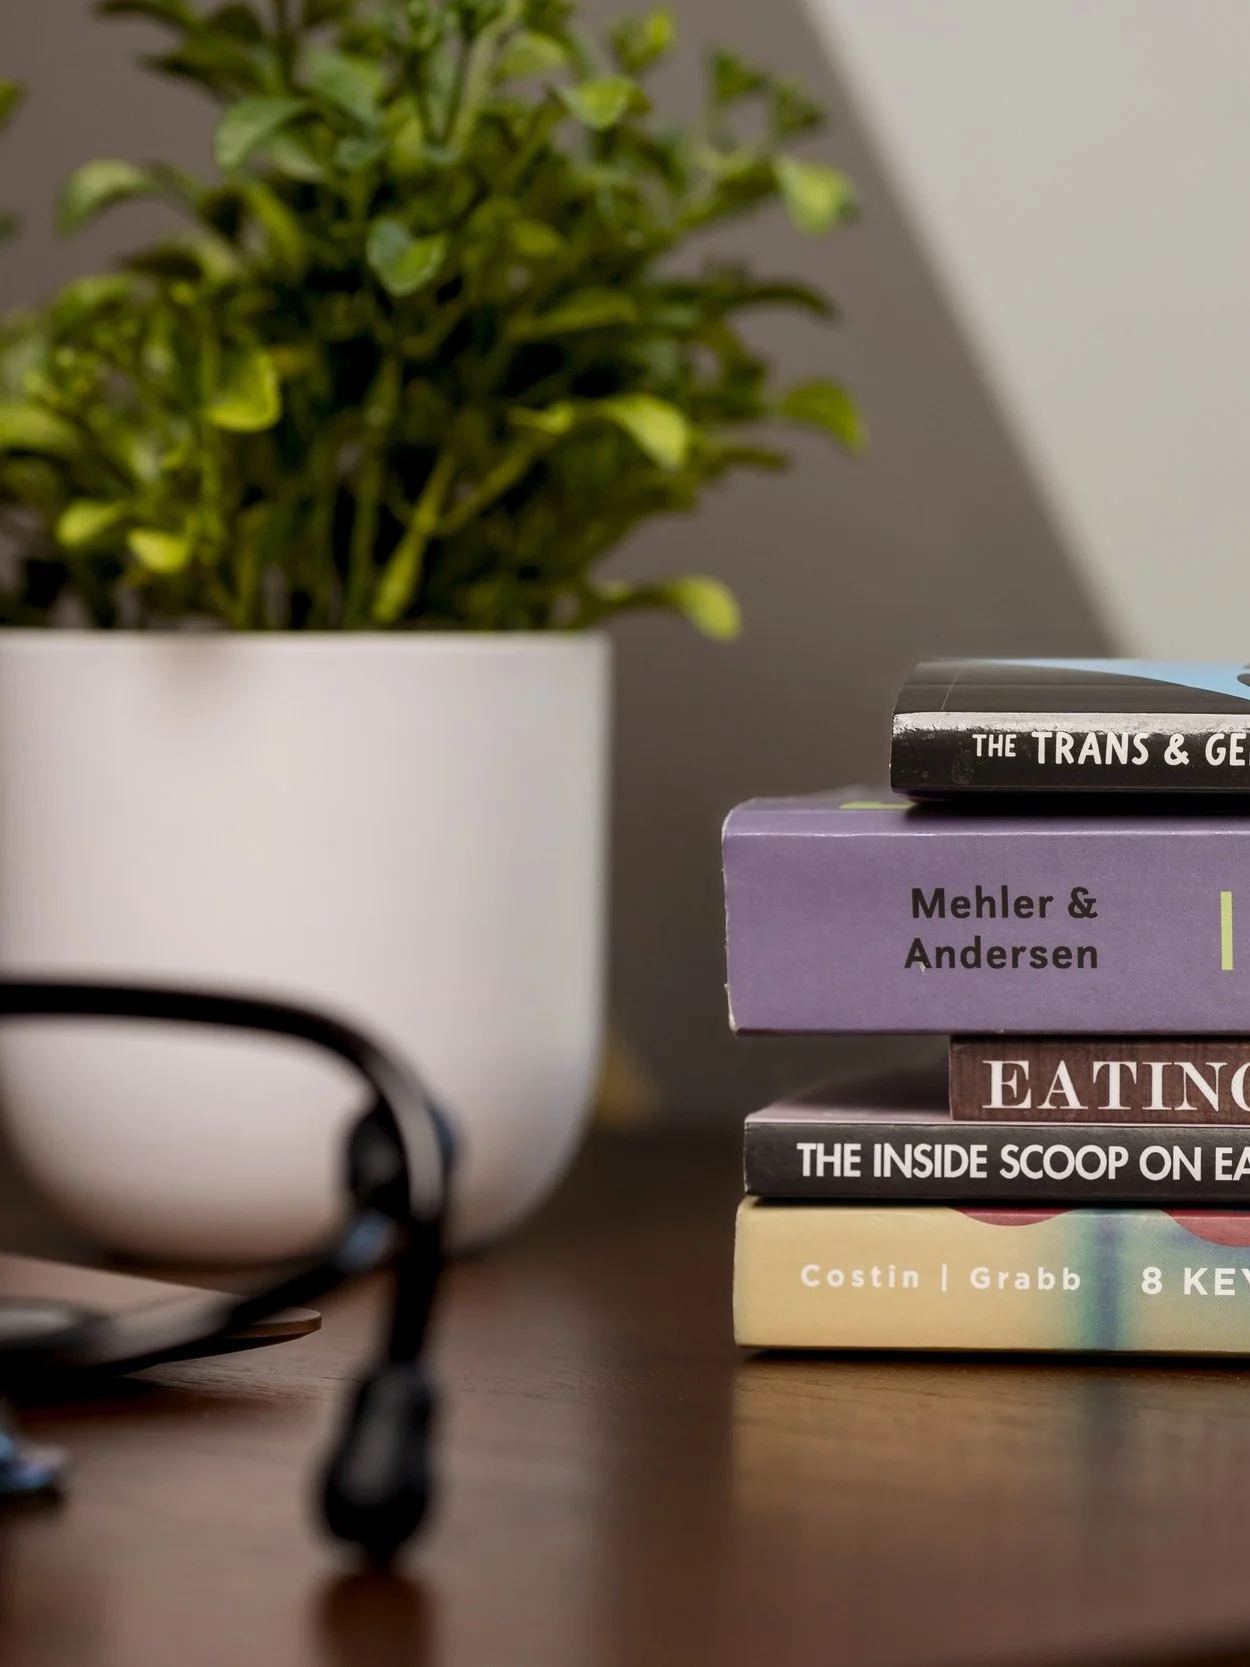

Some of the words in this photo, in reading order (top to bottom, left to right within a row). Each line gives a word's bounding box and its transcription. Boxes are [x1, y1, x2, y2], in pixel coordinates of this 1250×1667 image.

[973, 734, 1017, 757] THE
[1032, 731, 1149, 765] TRANS
[1164, 732, 1190, 765] &
[910, 886, 1054, 919] Mehler
[1068, 886, 1099, 919] &
[904, 936, 1099, 970] Andersen
[797, 1142, 862, 1177] THE
[873, 1143, 988, 1179] INSIDE
[1000, 1143, 1128, 1181] SCOOP
[1139, 1145, 1202, 1182] ON
[800, 1264, 920, 1288] Costin
[969, 1267, 1081, 1291] Grabb
[1141, 1266, 1164, 1296] 8
